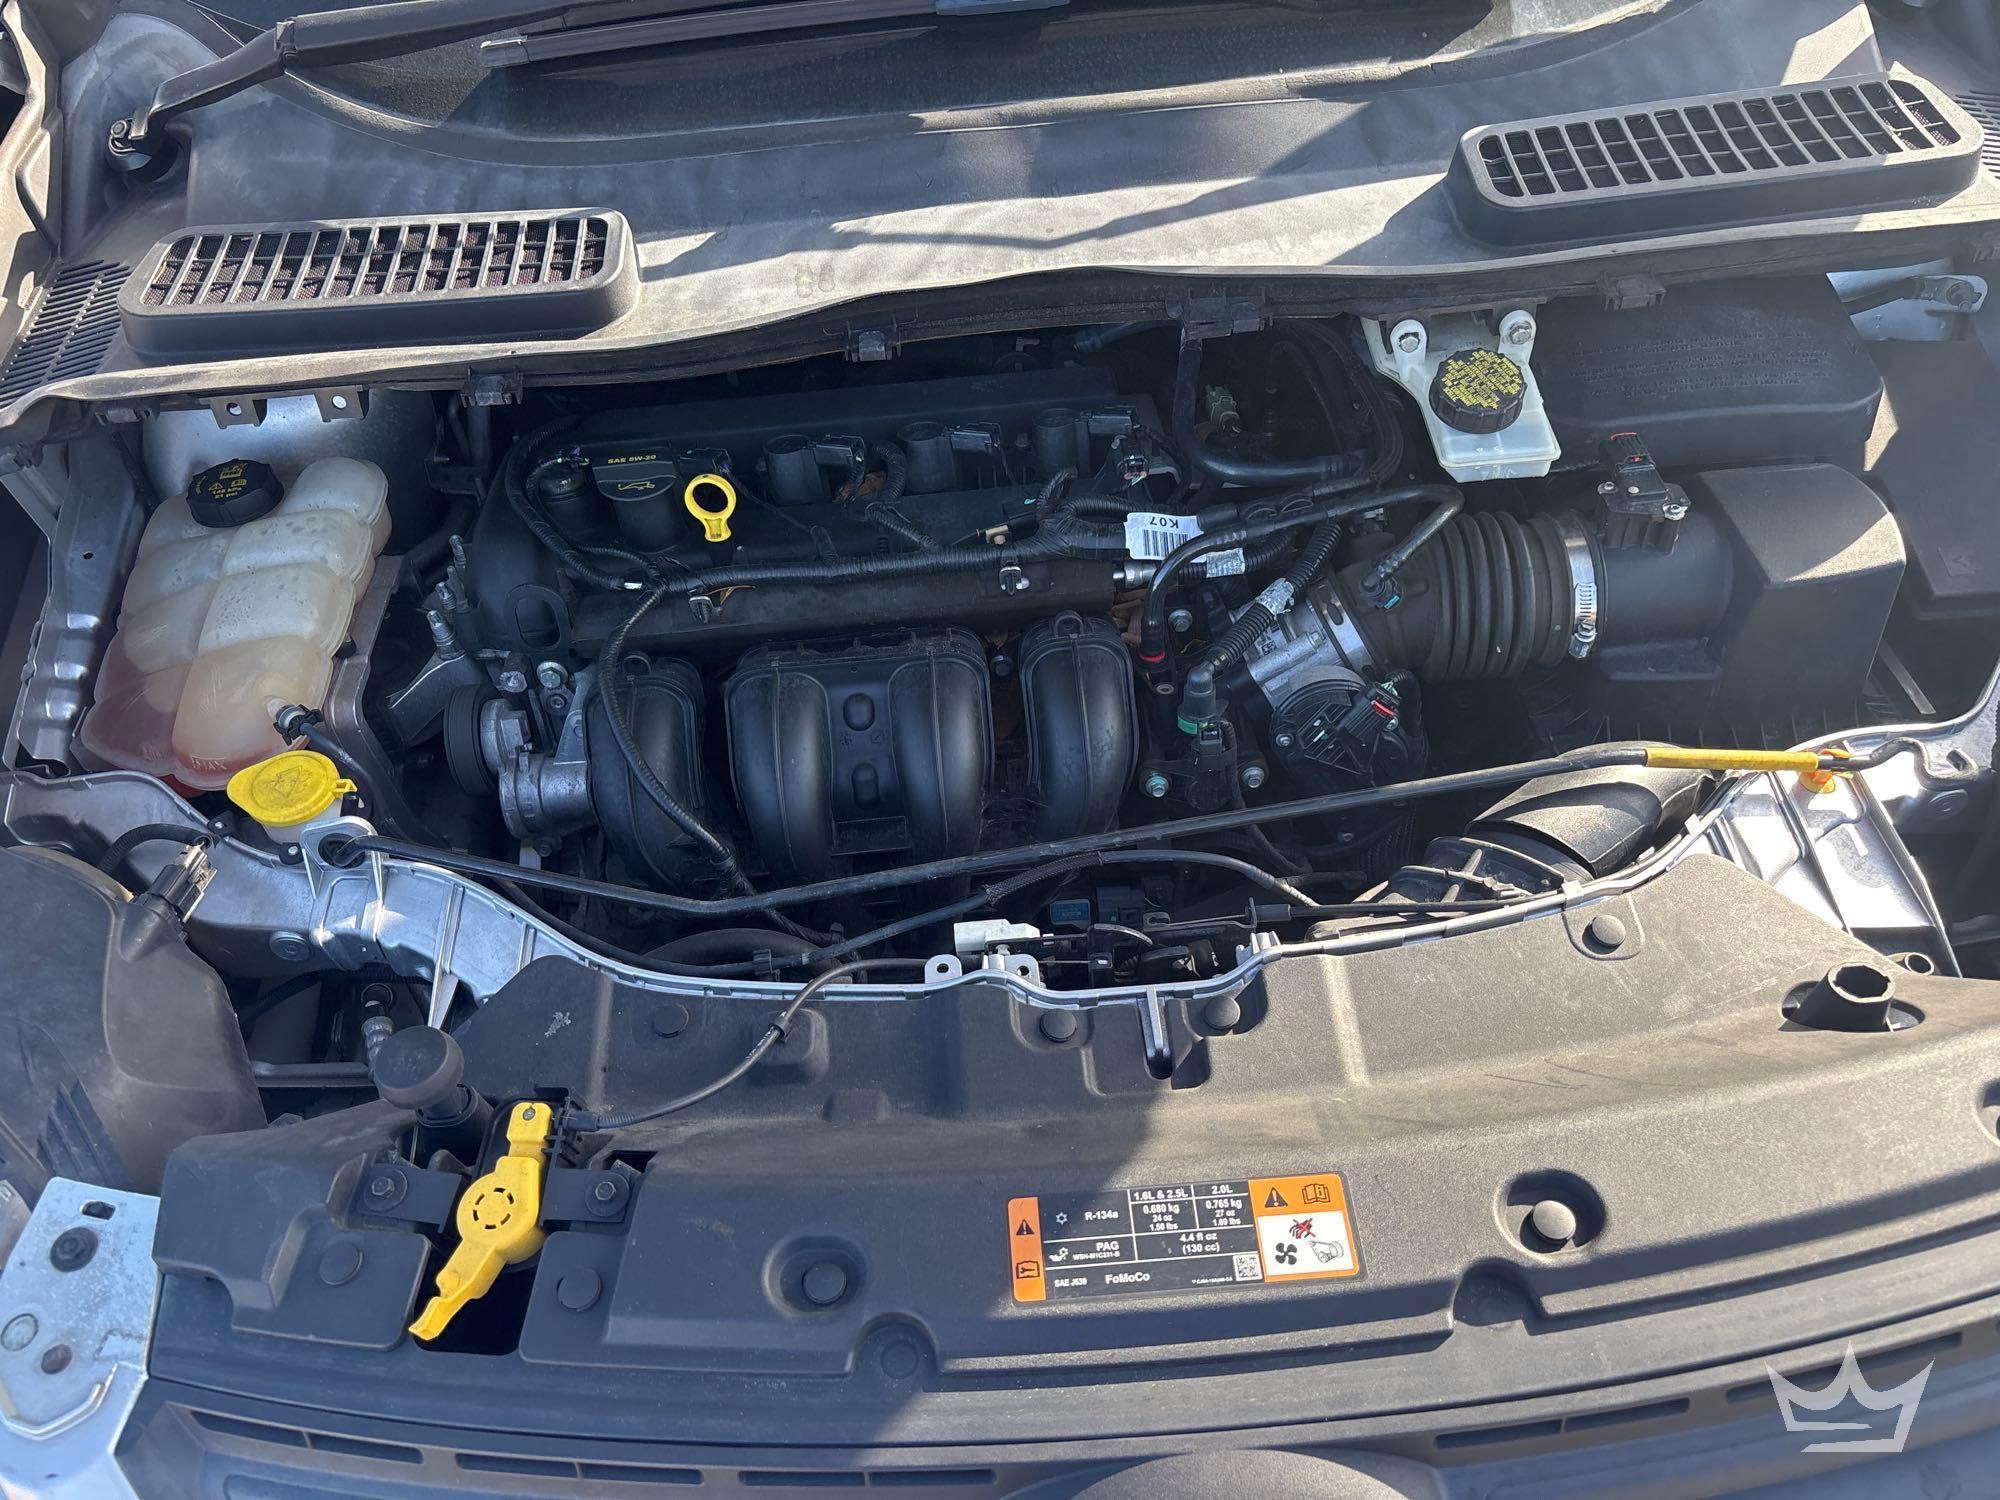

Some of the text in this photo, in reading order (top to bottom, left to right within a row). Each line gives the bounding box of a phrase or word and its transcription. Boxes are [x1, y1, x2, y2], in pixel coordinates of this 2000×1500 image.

[1150, 516, 1179, 529] K07
[1134, 1188, 1188, 1200] 1.6L & 2.5L
[1211, 1184, 1233, 1194] 2.0L
[1142, 1203, 1180, 1214] 0.680 kg
[1206, 1198, 1242, 1209] 0.765 kg
[1084, 1210, 1118, 1220] R-134a
[1152, 1214, 1162, 1222] 24
[1215, 1210, 1224, 1218] 27
[1150, 1222, 1178, 1231] 1.50 lbs
[1180, 1232, 1218, 1242] 4.4 fl oz
[1096, 1240, 1120, 1251] PAG
[1182, 1242, 1220, 1255] (130 cc)
[1054, 1278, 1070, 1288] SAE
[1105, 1272, 1150, 1284] FoMoCo
